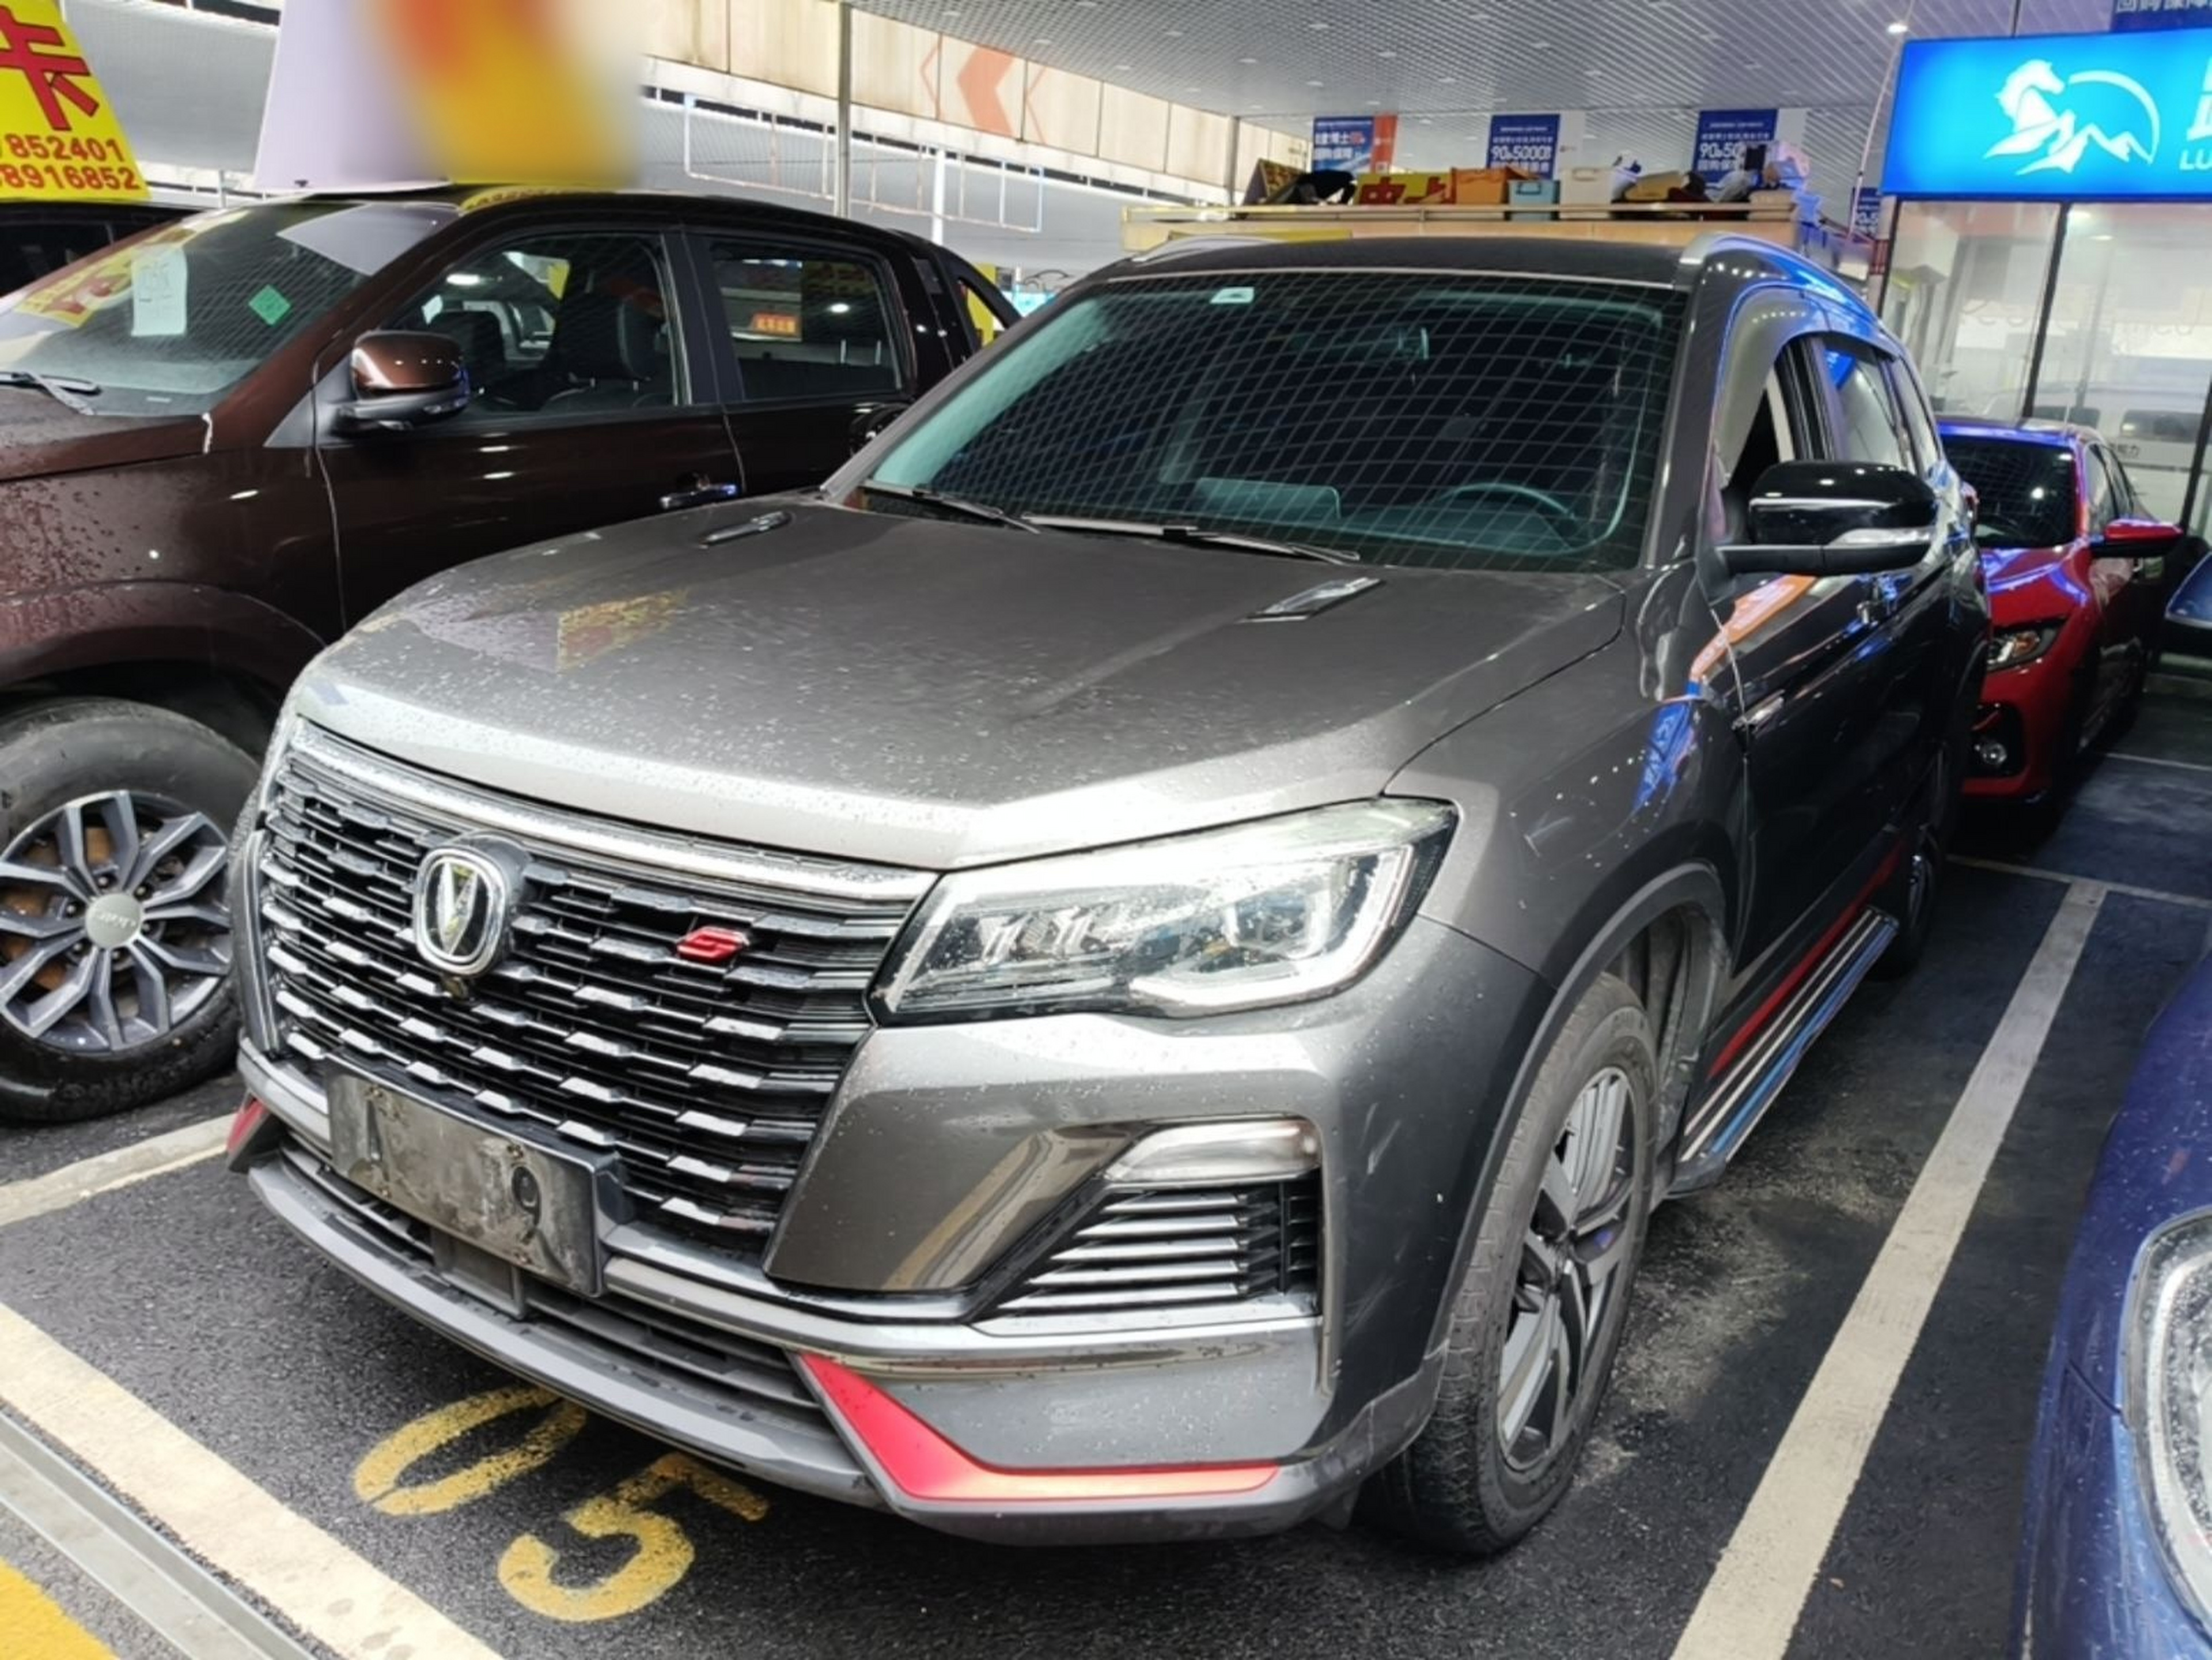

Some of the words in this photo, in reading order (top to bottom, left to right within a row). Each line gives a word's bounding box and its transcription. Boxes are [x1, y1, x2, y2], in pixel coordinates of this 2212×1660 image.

[0, 133, 125, 163] 852401
[0, 163, 141, 191] 8916852
[353, 1384, 770, 1623] 05
